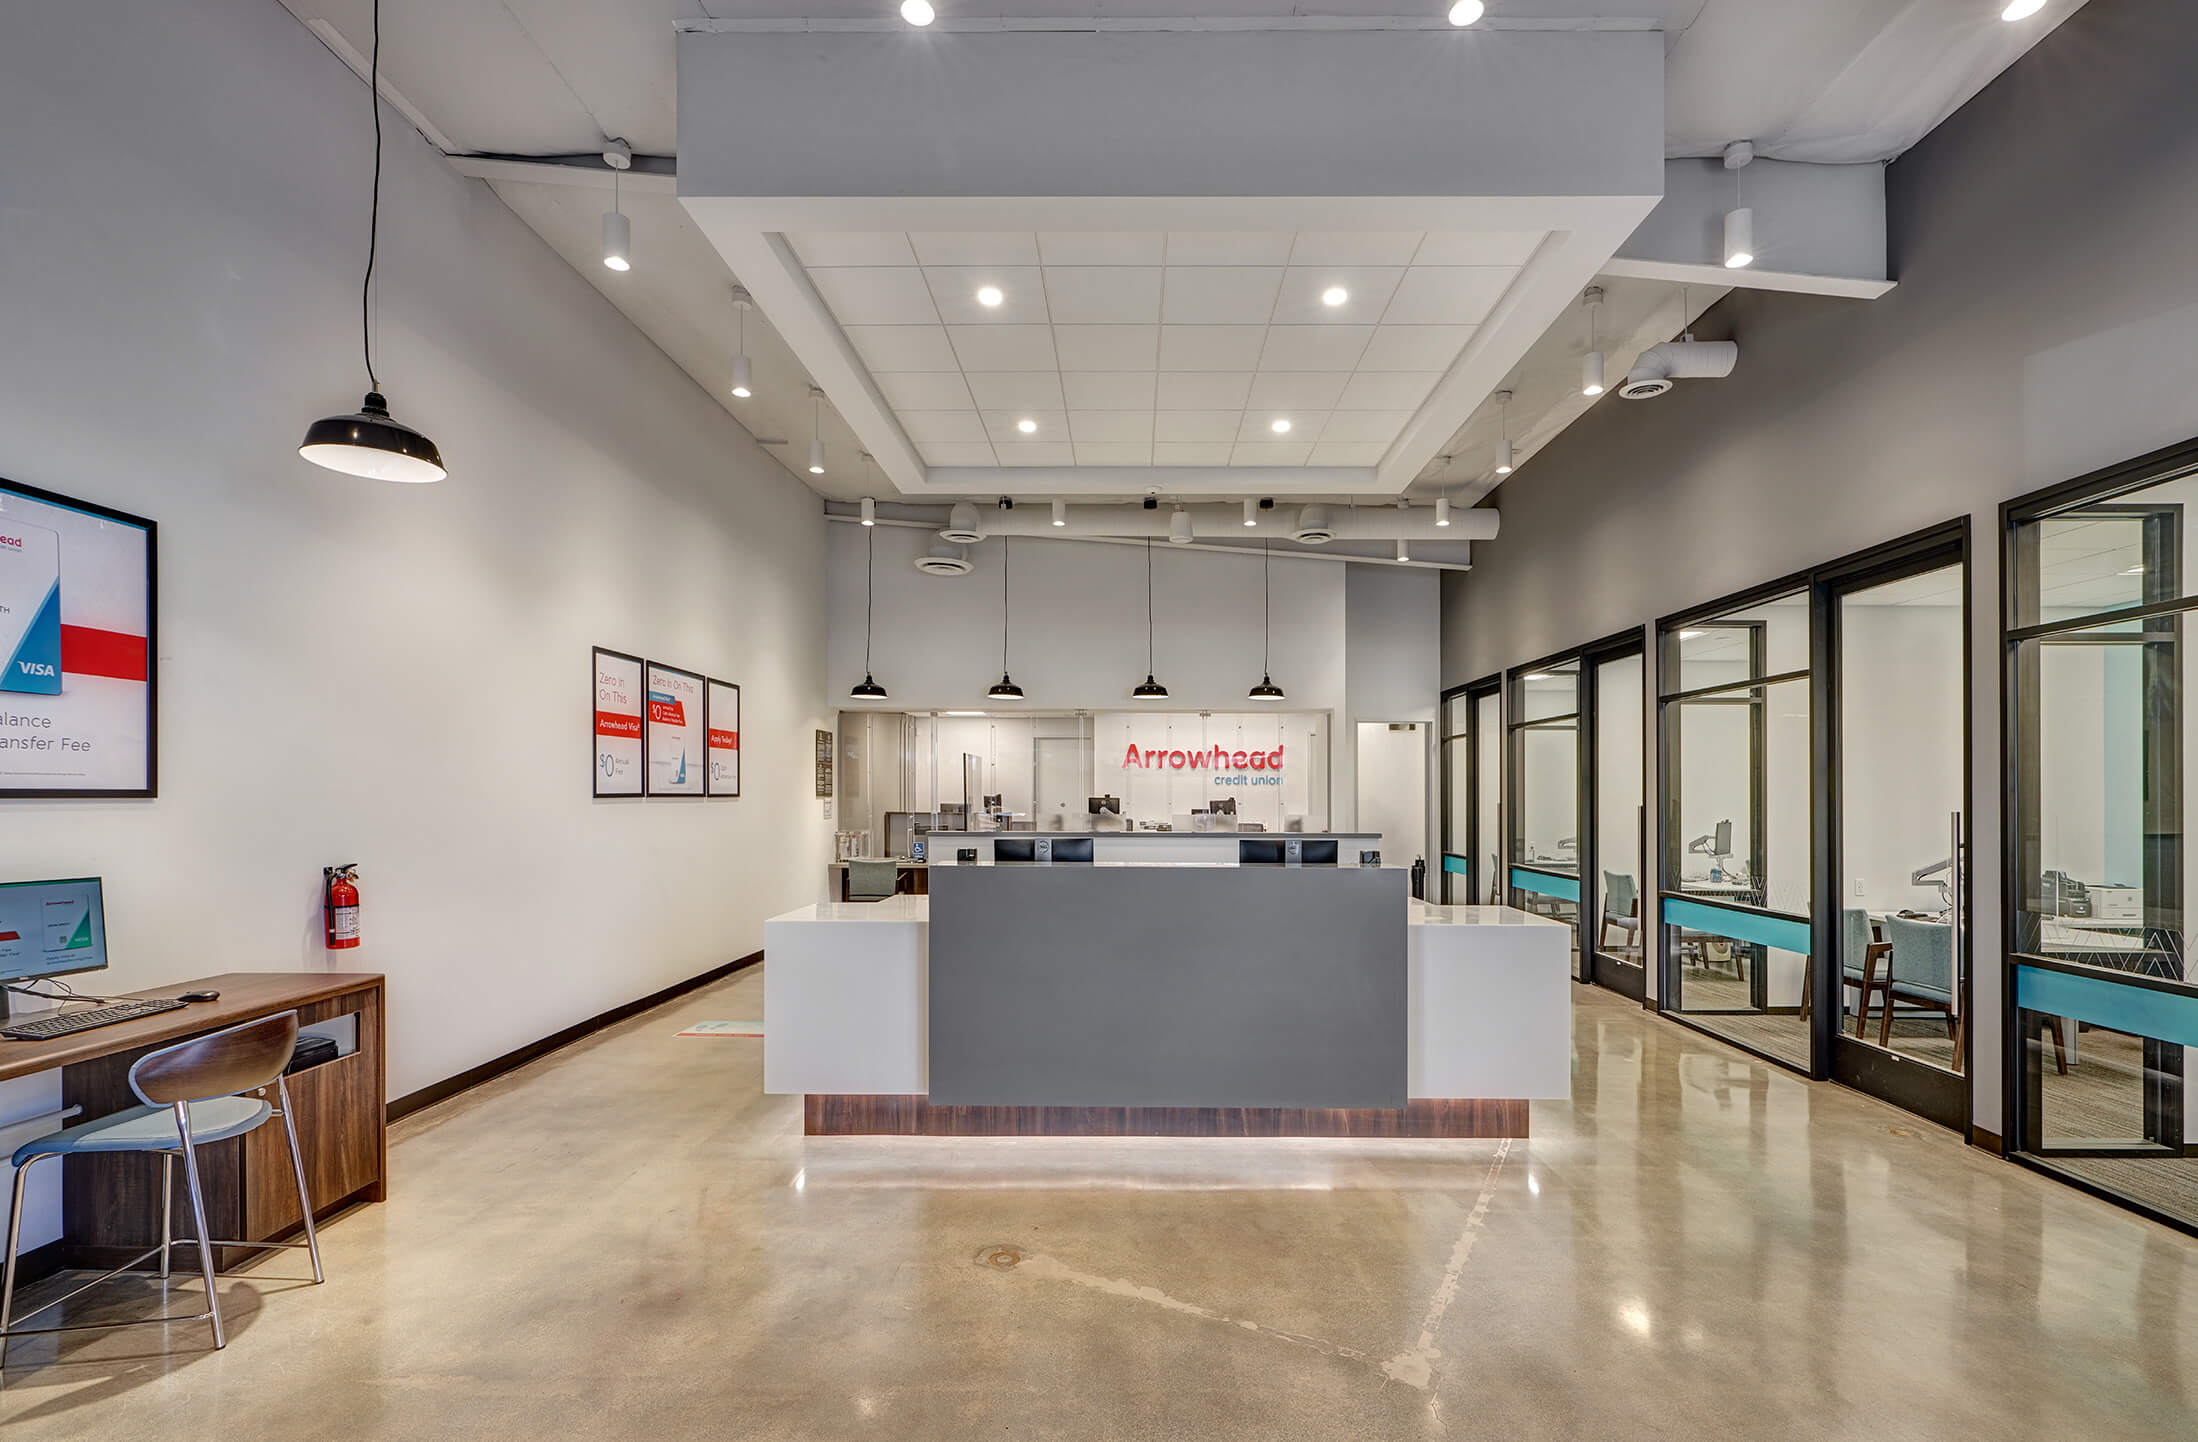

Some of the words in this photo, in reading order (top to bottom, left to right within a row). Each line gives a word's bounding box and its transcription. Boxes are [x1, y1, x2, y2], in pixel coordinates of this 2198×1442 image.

[17, 661, 55, 677] VISA
[600, 672, 616, 686] Zero
[600, 689, 610, 701] On
[613, 691, 627, 704] This
[0, 711, 51, 728] lance
[600, 719, 628, 731] Arrowhead
[62, 737, 91, 752] Fee
[1122, 743, 1283, 770] Arrowhead
[600, 753, 614, 777] $0
[1214, 775, 1247, 785] credit
[1251, 775, 1283, 786] union
